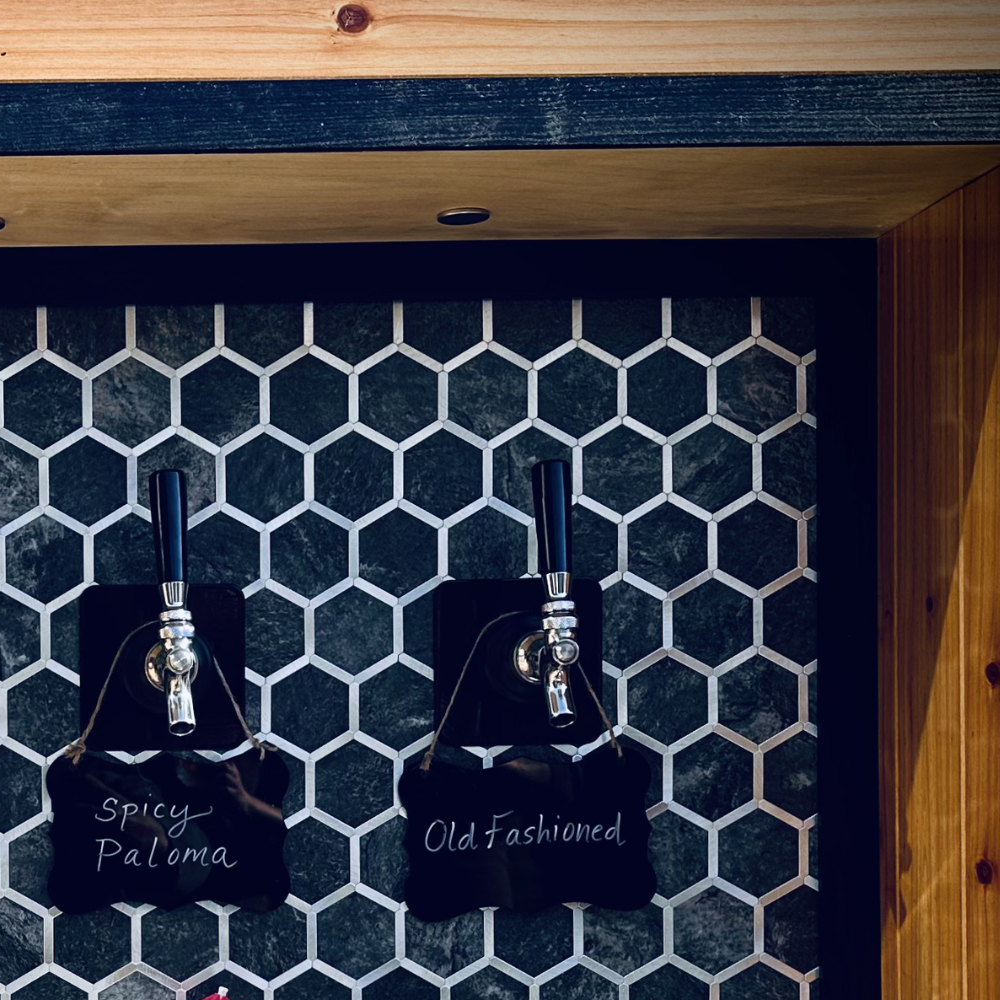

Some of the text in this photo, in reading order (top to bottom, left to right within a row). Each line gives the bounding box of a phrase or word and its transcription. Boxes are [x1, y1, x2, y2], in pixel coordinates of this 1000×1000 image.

[94, 793, 213, 838] Spicy
[424, 810, 626, 853] Old Fashioned
[95, 837, 238, 872] Paloma
